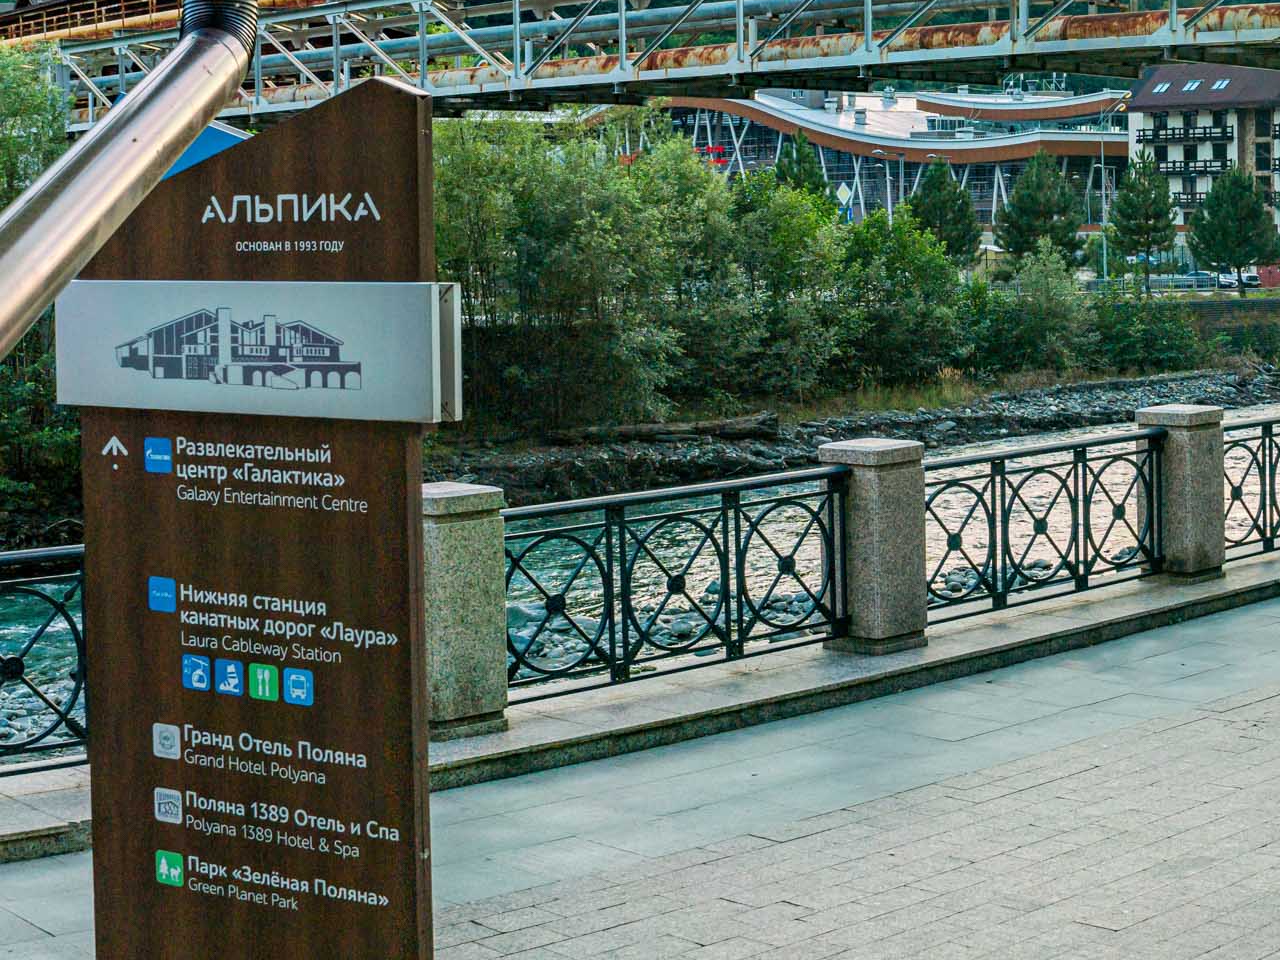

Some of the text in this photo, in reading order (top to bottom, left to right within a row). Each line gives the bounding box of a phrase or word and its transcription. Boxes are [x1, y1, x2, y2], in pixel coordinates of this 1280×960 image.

[202, 192, 380, 223] АЛЬПИКА
[235, 241, 344, 252] ОСНОВАН В 1993 ГОДУ
[177, 437, 331, 463] Развлекательный
[177, 463, 345, 487] центр «Галактика»
[177, 485, 367, 512] Galaxy Entertainment Centre
[180, 584, 248, 608] Нижняя
[253, 596, 326, 616] станция
[181, 611, 398, 648] канатных дорог «Лаура»
[181, 632, 341, 662] Laura Cableway Station
[184, 724, 366, 767] Гранд Отель Поляна
[184, 749, 325, 784] Grand Hotel Polyana
[186, 791, 244, 816] Поляна
[251, 803, 289, 823] 1389
[295, 810, 345, 832] Отель
[351, 822, 360, 835] и
[367, 821, 399, 841] Спа
[187, 815, 359, 858] Polyana 1389 Hotel & Spa
[188, 856, 388, 905] Парк «Зелёная Поляна»
[188, 878, 298, 910] Green Planet Park
